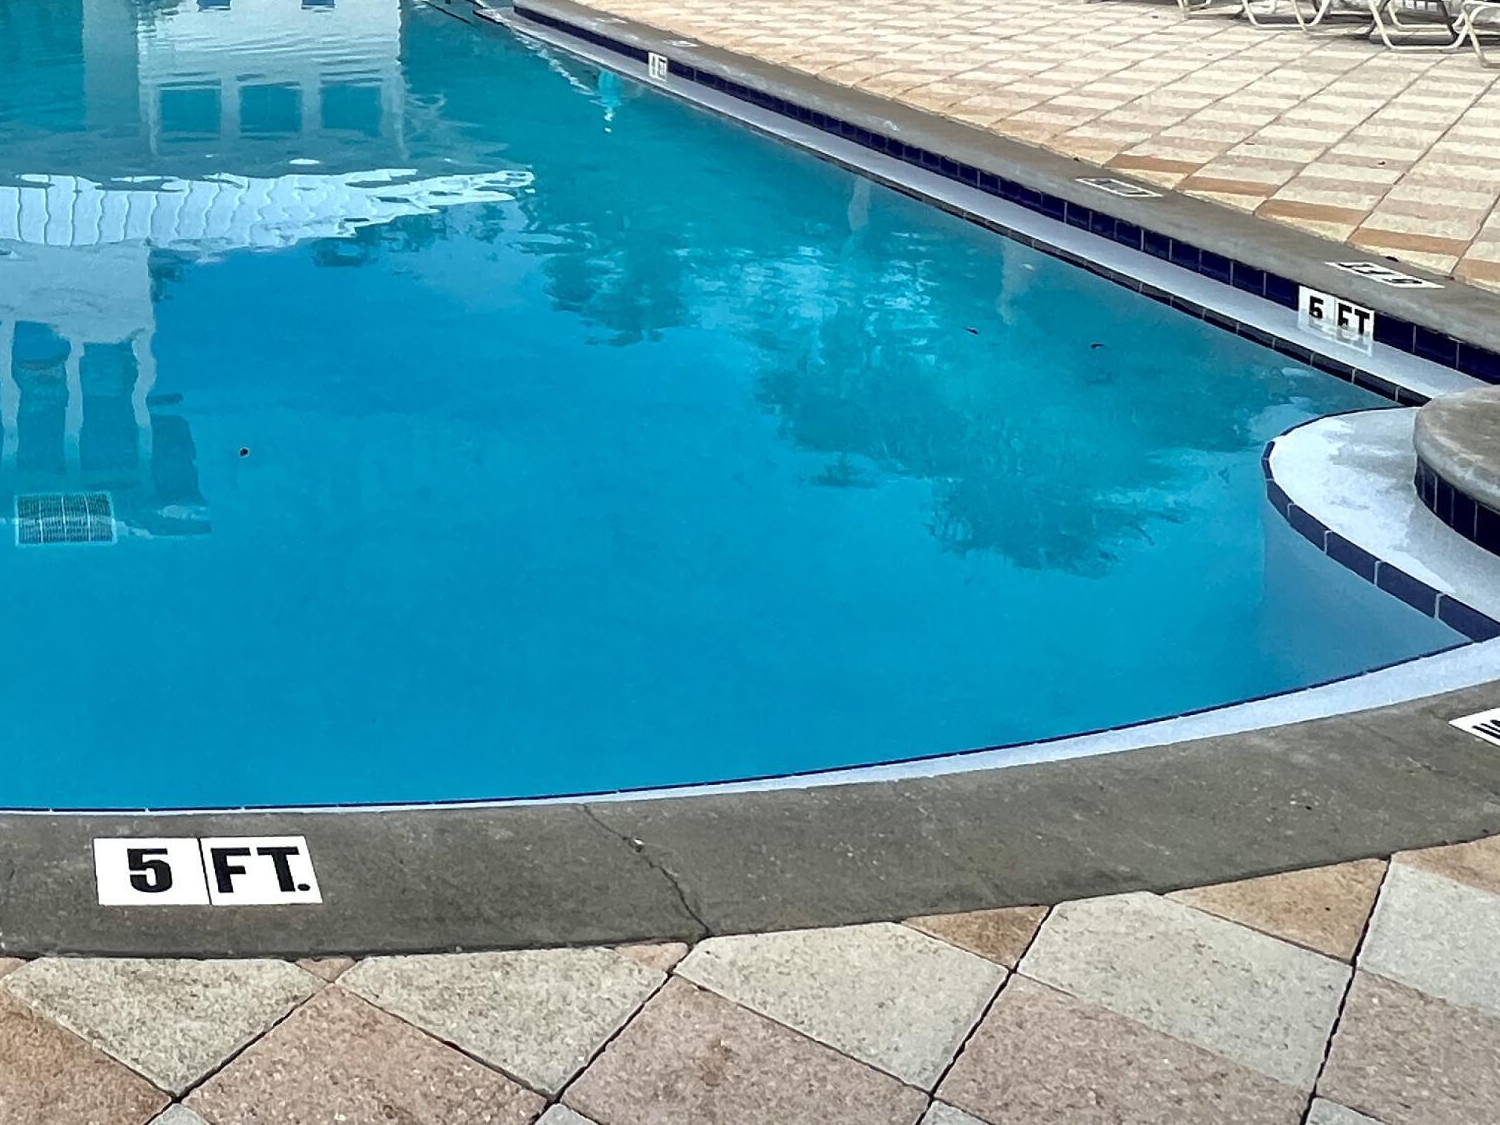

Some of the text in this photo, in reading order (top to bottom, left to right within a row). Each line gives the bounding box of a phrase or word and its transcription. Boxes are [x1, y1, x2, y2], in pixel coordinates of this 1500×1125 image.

[1308, 295, 1371, 335] 5 FT
[127, 845, 312, 894] 5 FT.
